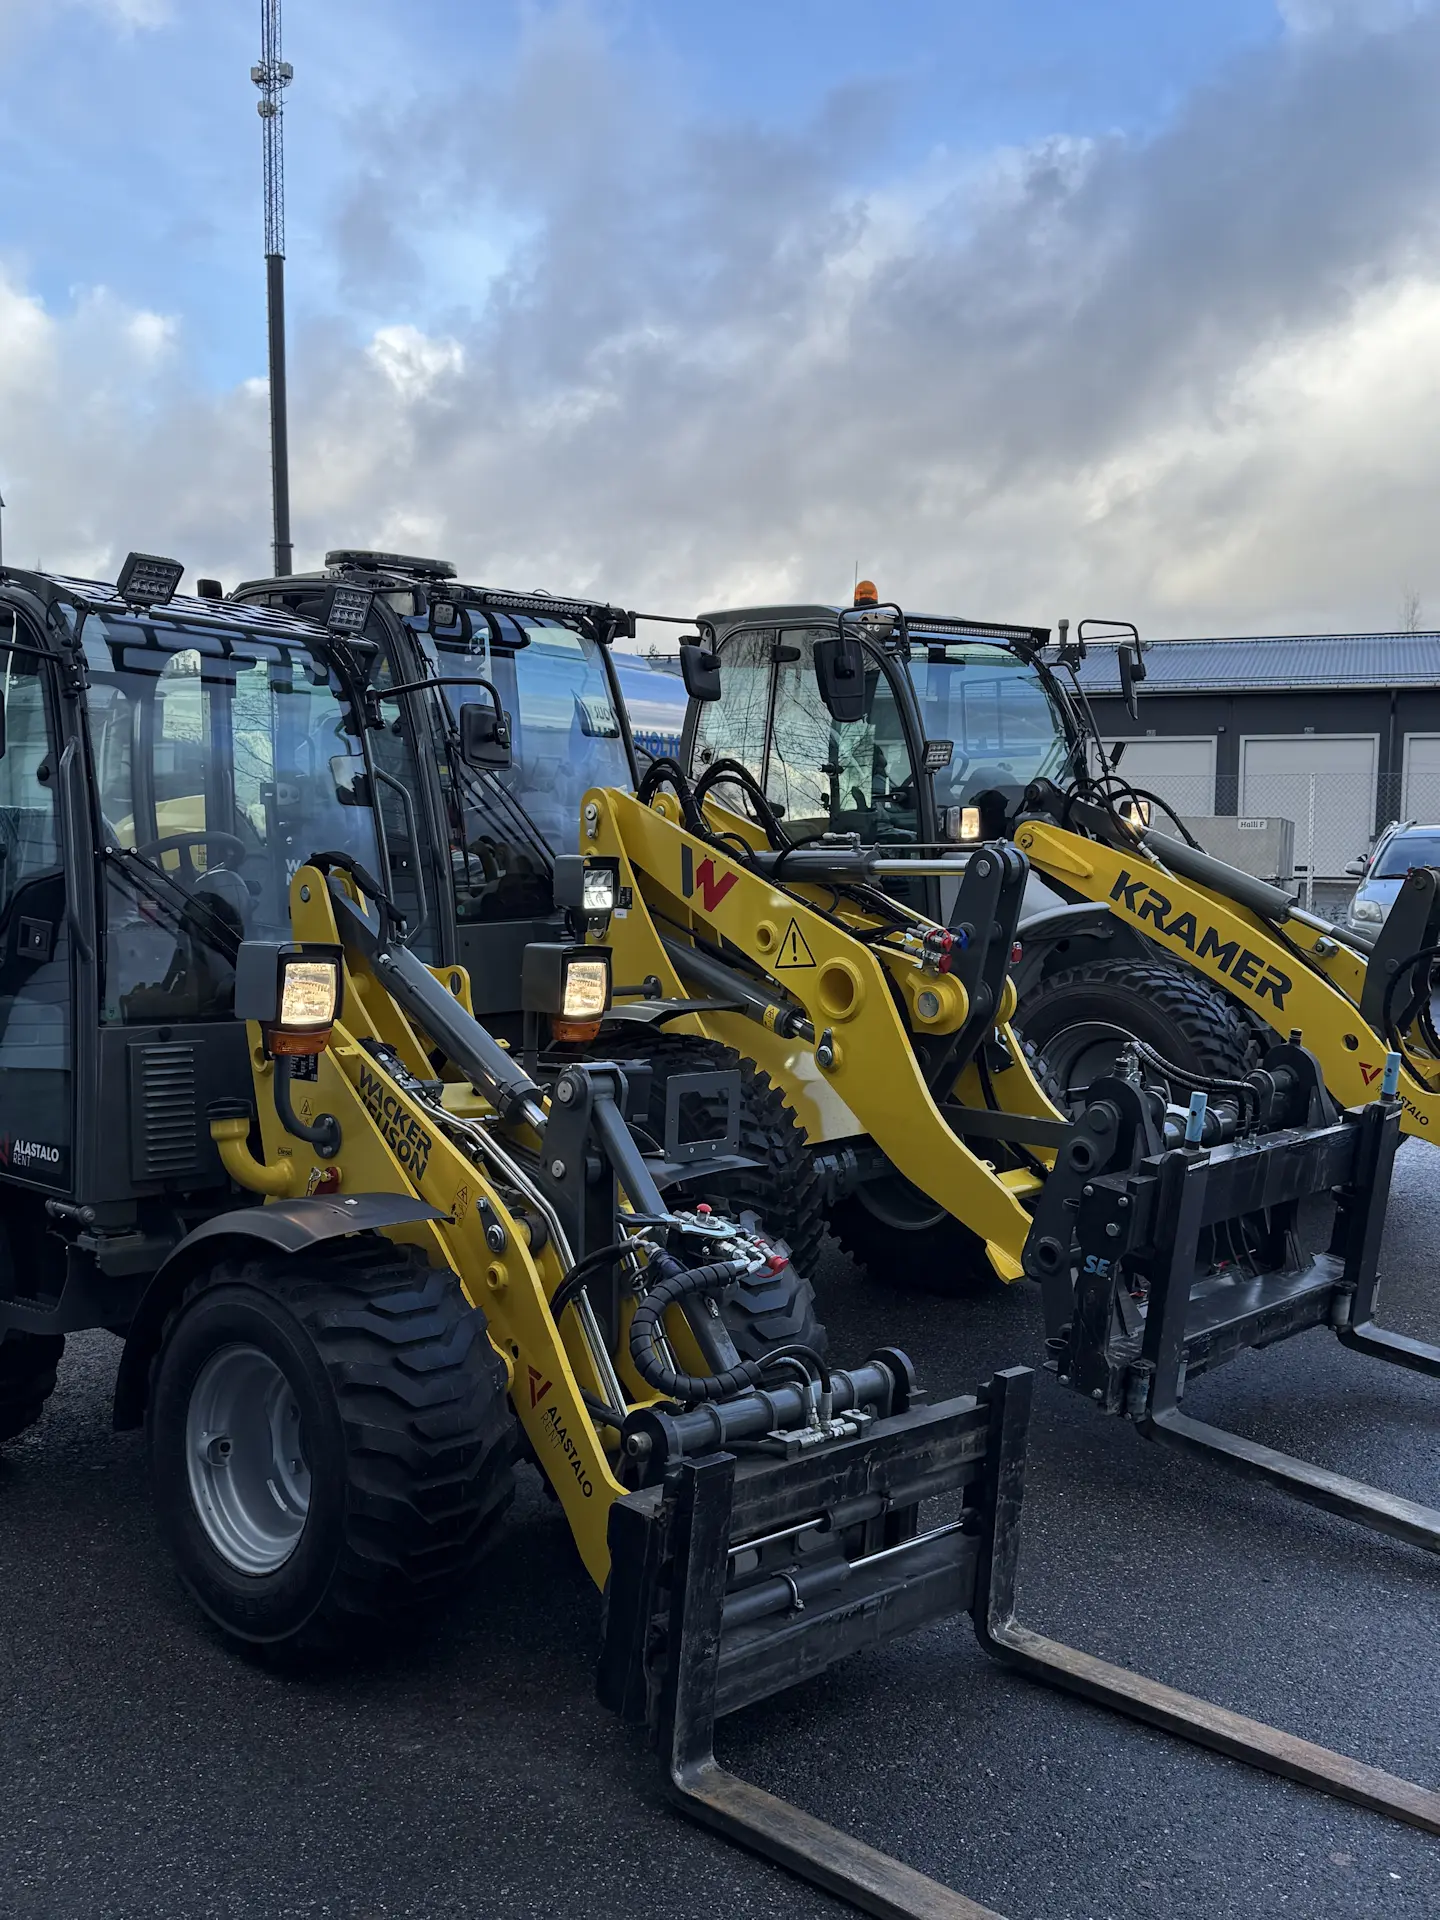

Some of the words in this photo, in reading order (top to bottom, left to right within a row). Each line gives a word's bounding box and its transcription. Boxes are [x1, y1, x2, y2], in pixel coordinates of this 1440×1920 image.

[1109, 870, 1292, 1011] KRAMER
[360, 1064, 432, 1160] WACKER
[1383, 1084, 1429, 1125] ASTALO
[12, 1152, 31, 1167] RENT
[13, 1139, 60, 1163] ALASTALO
[540, 1411, 562, 1449] RENT
[548, 1406, 593, 1498] ALASTALO
